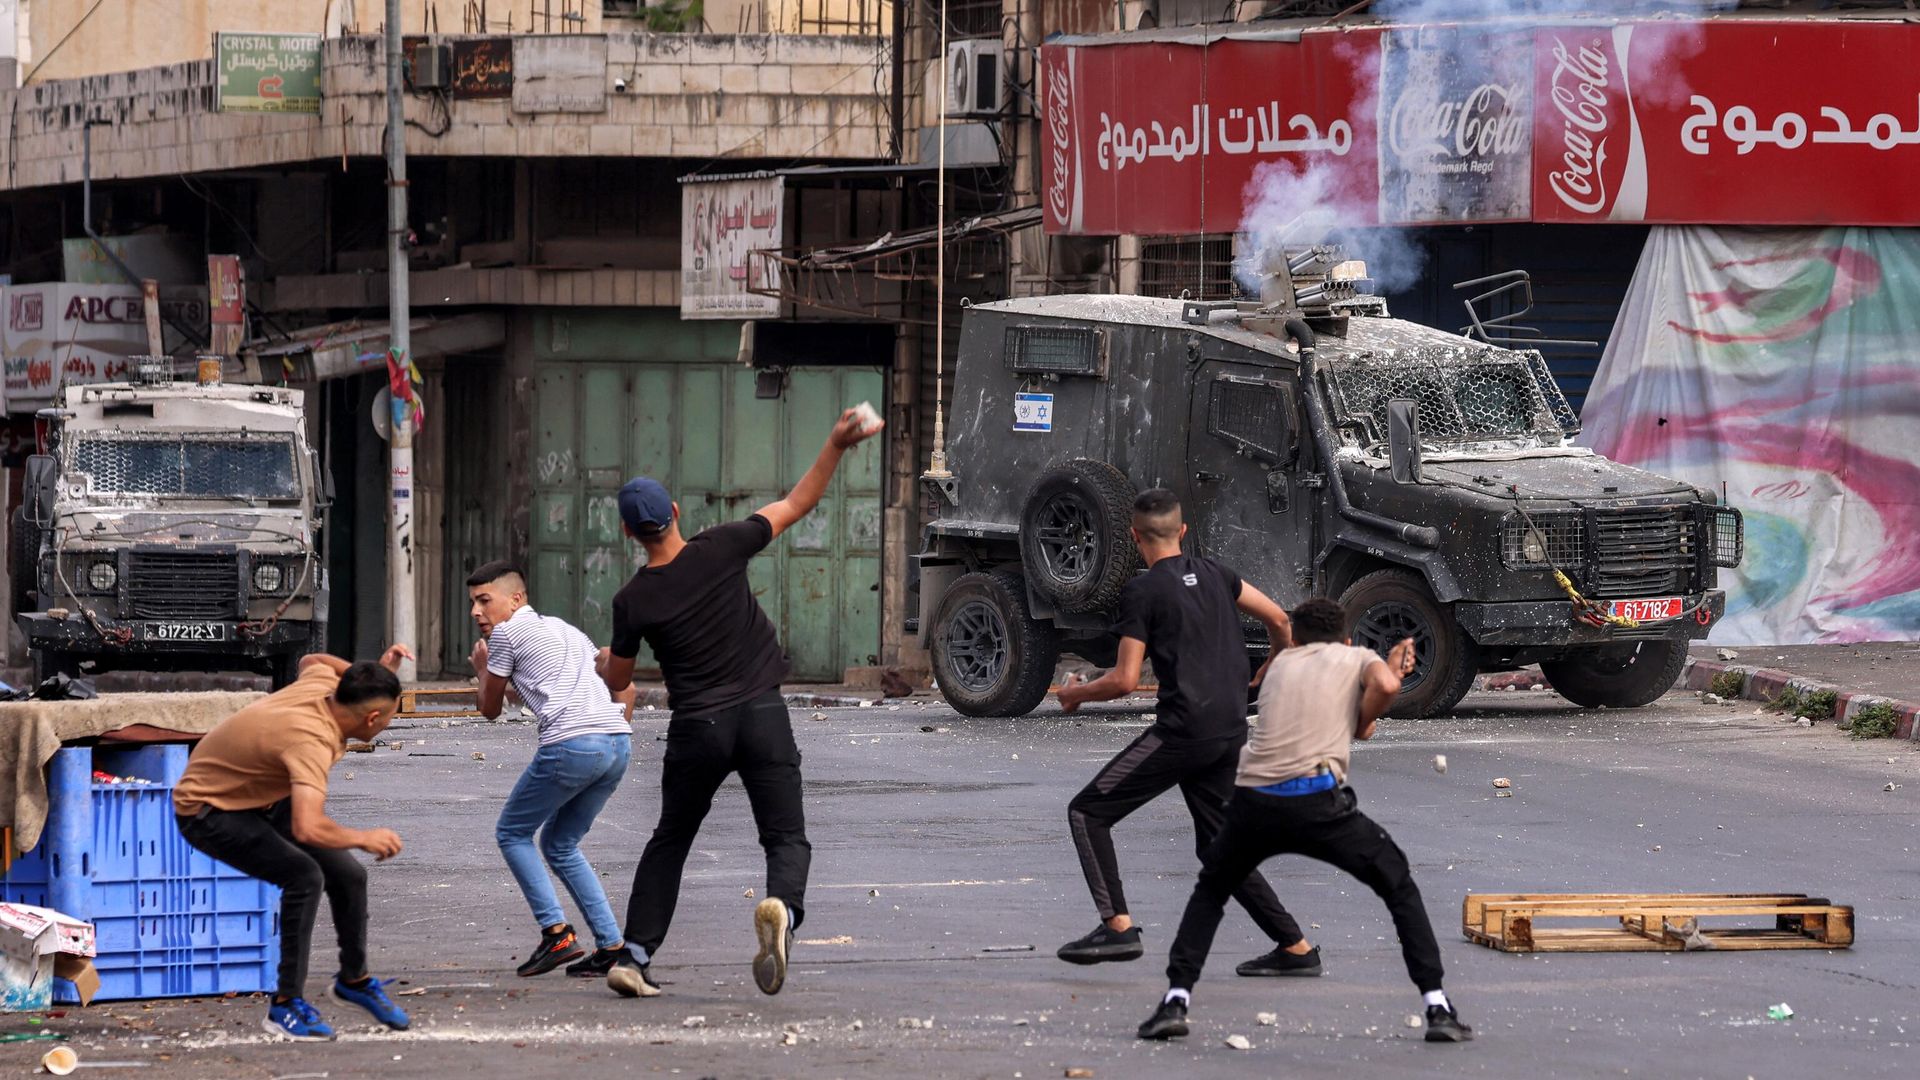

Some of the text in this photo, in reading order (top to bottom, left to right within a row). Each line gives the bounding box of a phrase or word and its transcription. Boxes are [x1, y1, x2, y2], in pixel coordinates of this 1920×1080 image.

[223, 37, 320, 51] CRYSTAL MOTEL
[227, 53, 315, 71] موتيل كريستال
[1048, 52, 1069, 226] Coca-Cola
[1097, 101, 1352, 170] محلات المدموج
[1389, 84, 1525, 156] Coca-Cola
[1549, 35, 1608, 213] Coca-Cola
[1681, 93, 1920, 155] مدموج
[1470, 161, 1494, 174] Regd
[64, 296, 122, 323] APC
[1624, 601, 1669, 619] 61-7182
